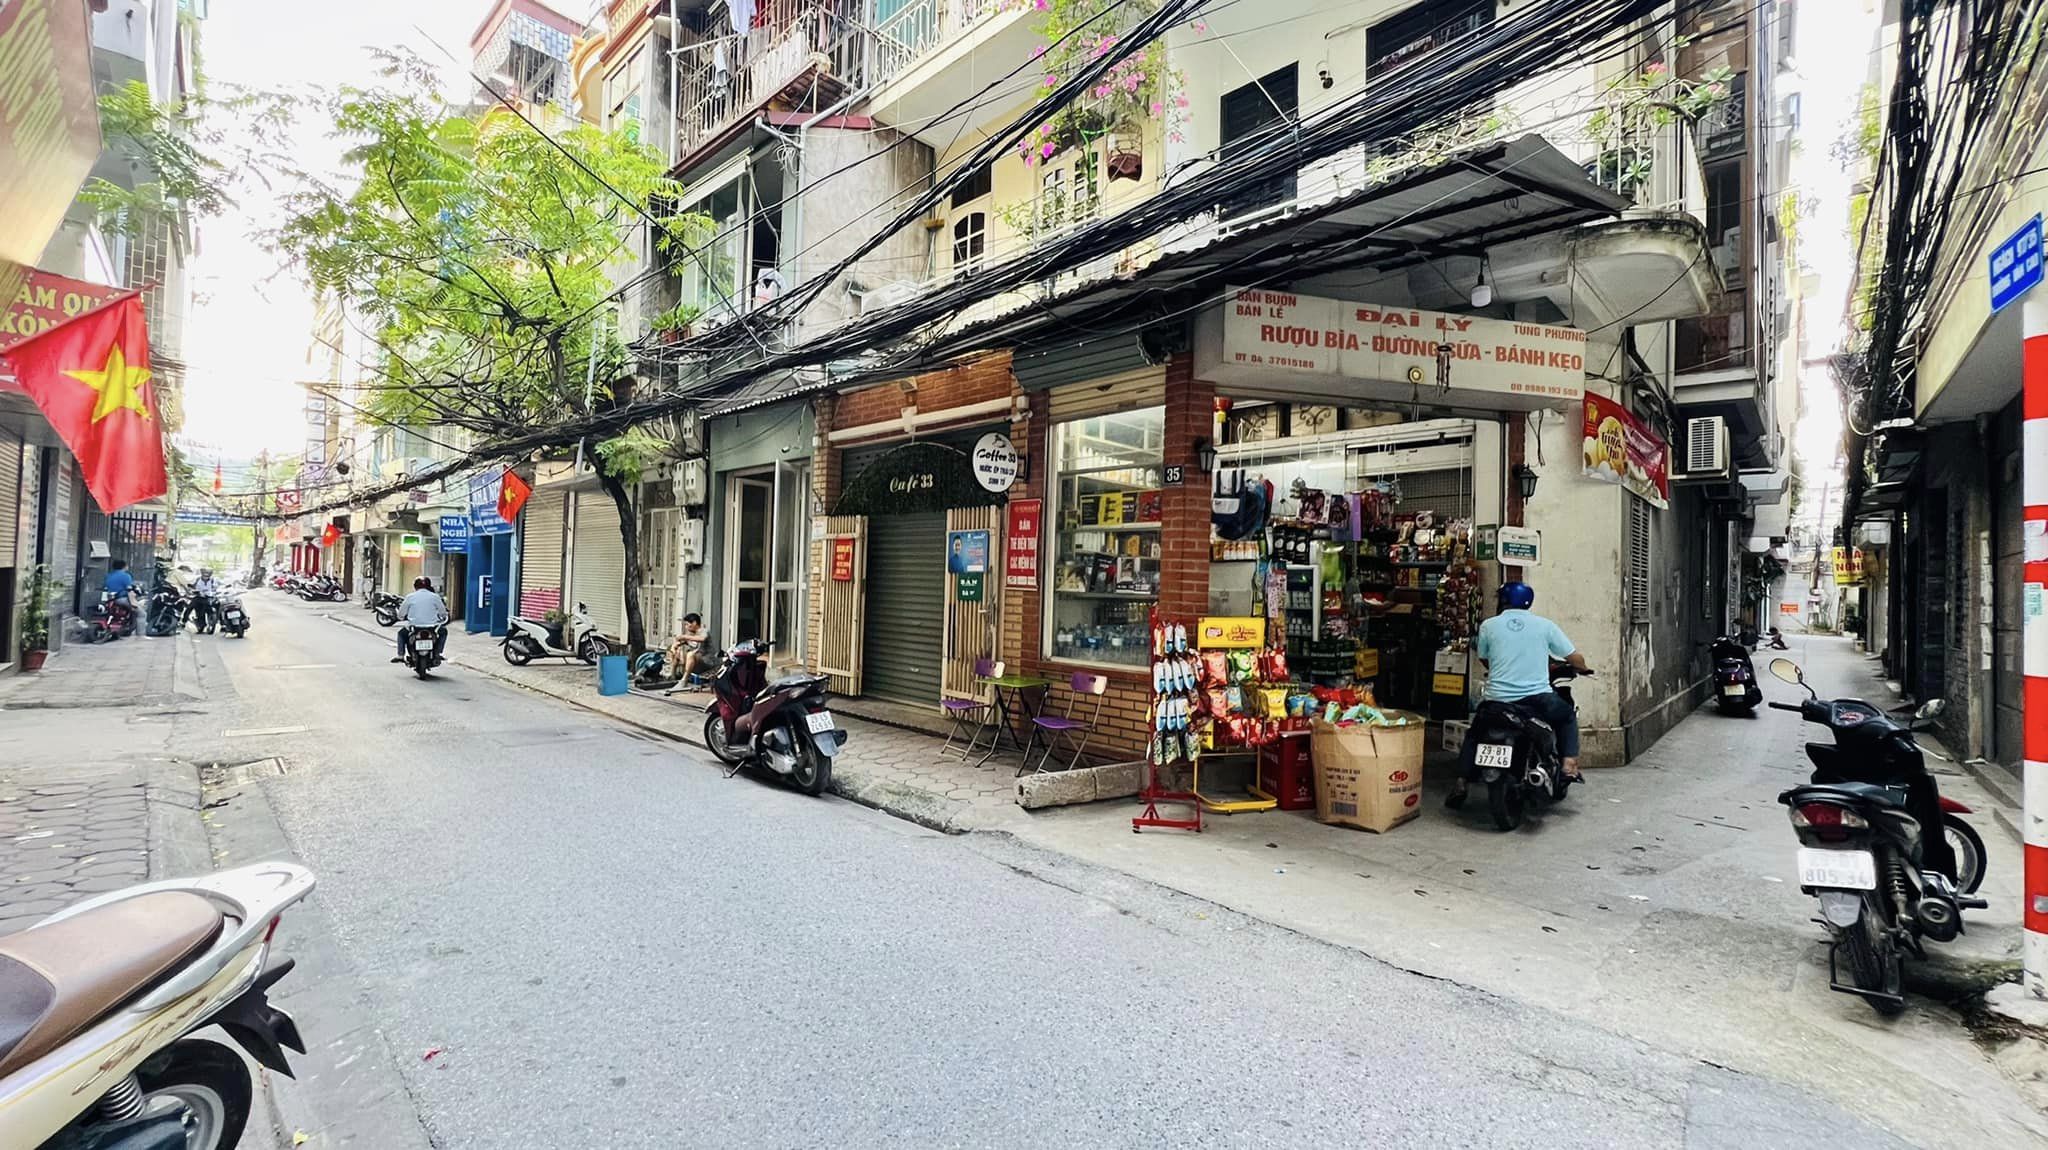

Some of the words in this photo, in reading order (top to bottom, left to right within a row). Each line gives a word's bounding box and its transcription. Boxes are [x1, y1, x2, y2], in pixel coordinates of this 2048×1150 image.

[1261, 324, 1319, 348] RƯỢU
[1372, 335, 1440, 358] ĐƯỜNG
[1495, 344, 1545, 367] BÁNH
[1548, 351, 1583, 373] KẸO
[976, 448, 1007, 462] Coffee
[1166, 467, 1180, 482] 35
[889, 475, 919, 493] Café
[920, 473, 934, 488] 33
[442, 514, 465, 527] NHÀ
[1018, 518, 1031, 531] BÁN
